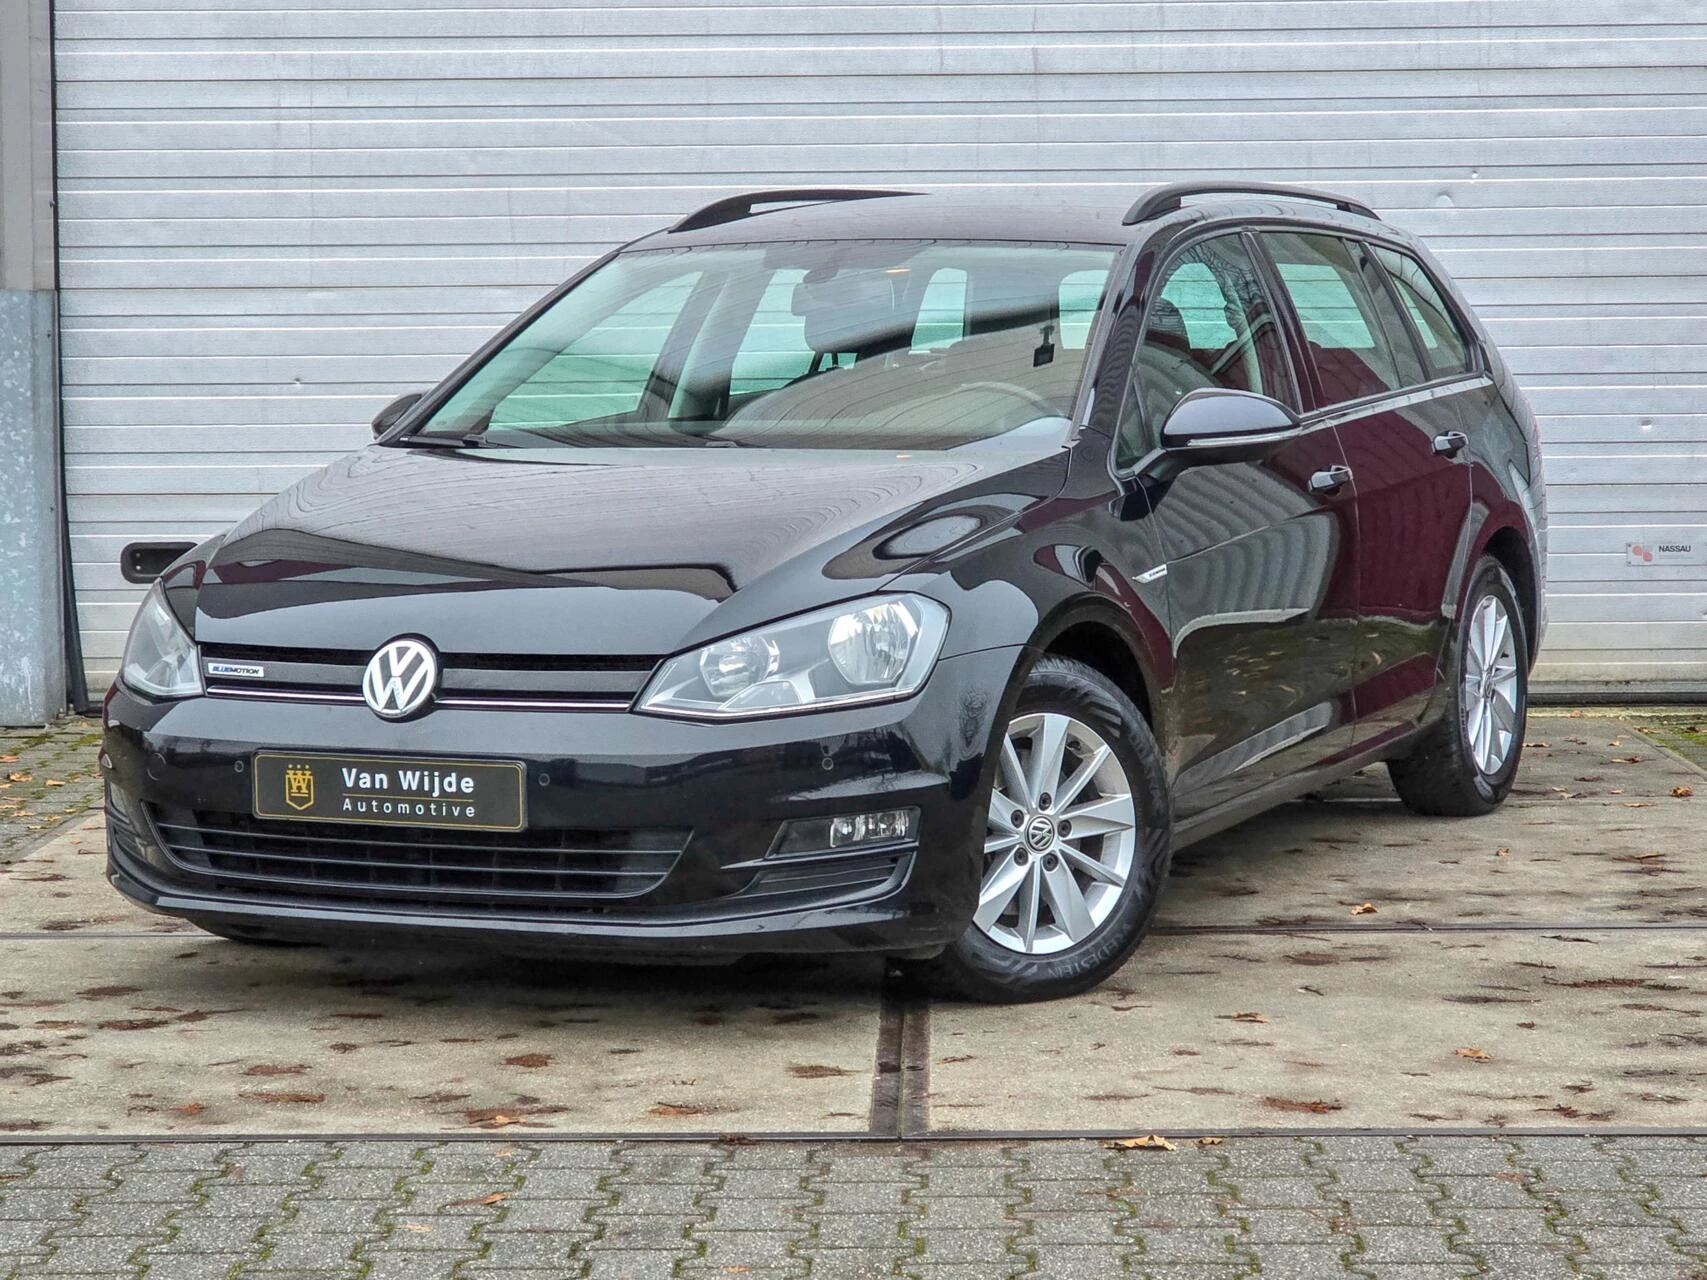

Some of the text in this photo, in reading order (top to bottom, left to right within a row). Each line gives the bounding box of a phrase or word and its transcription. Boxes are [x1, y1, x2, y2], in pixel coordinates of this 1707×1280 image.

[212, 666, 260, 674] BLUEMOTION
[341, 767, 475, 797] Van Wijde
[342, 798, 476, 818] Automotive
